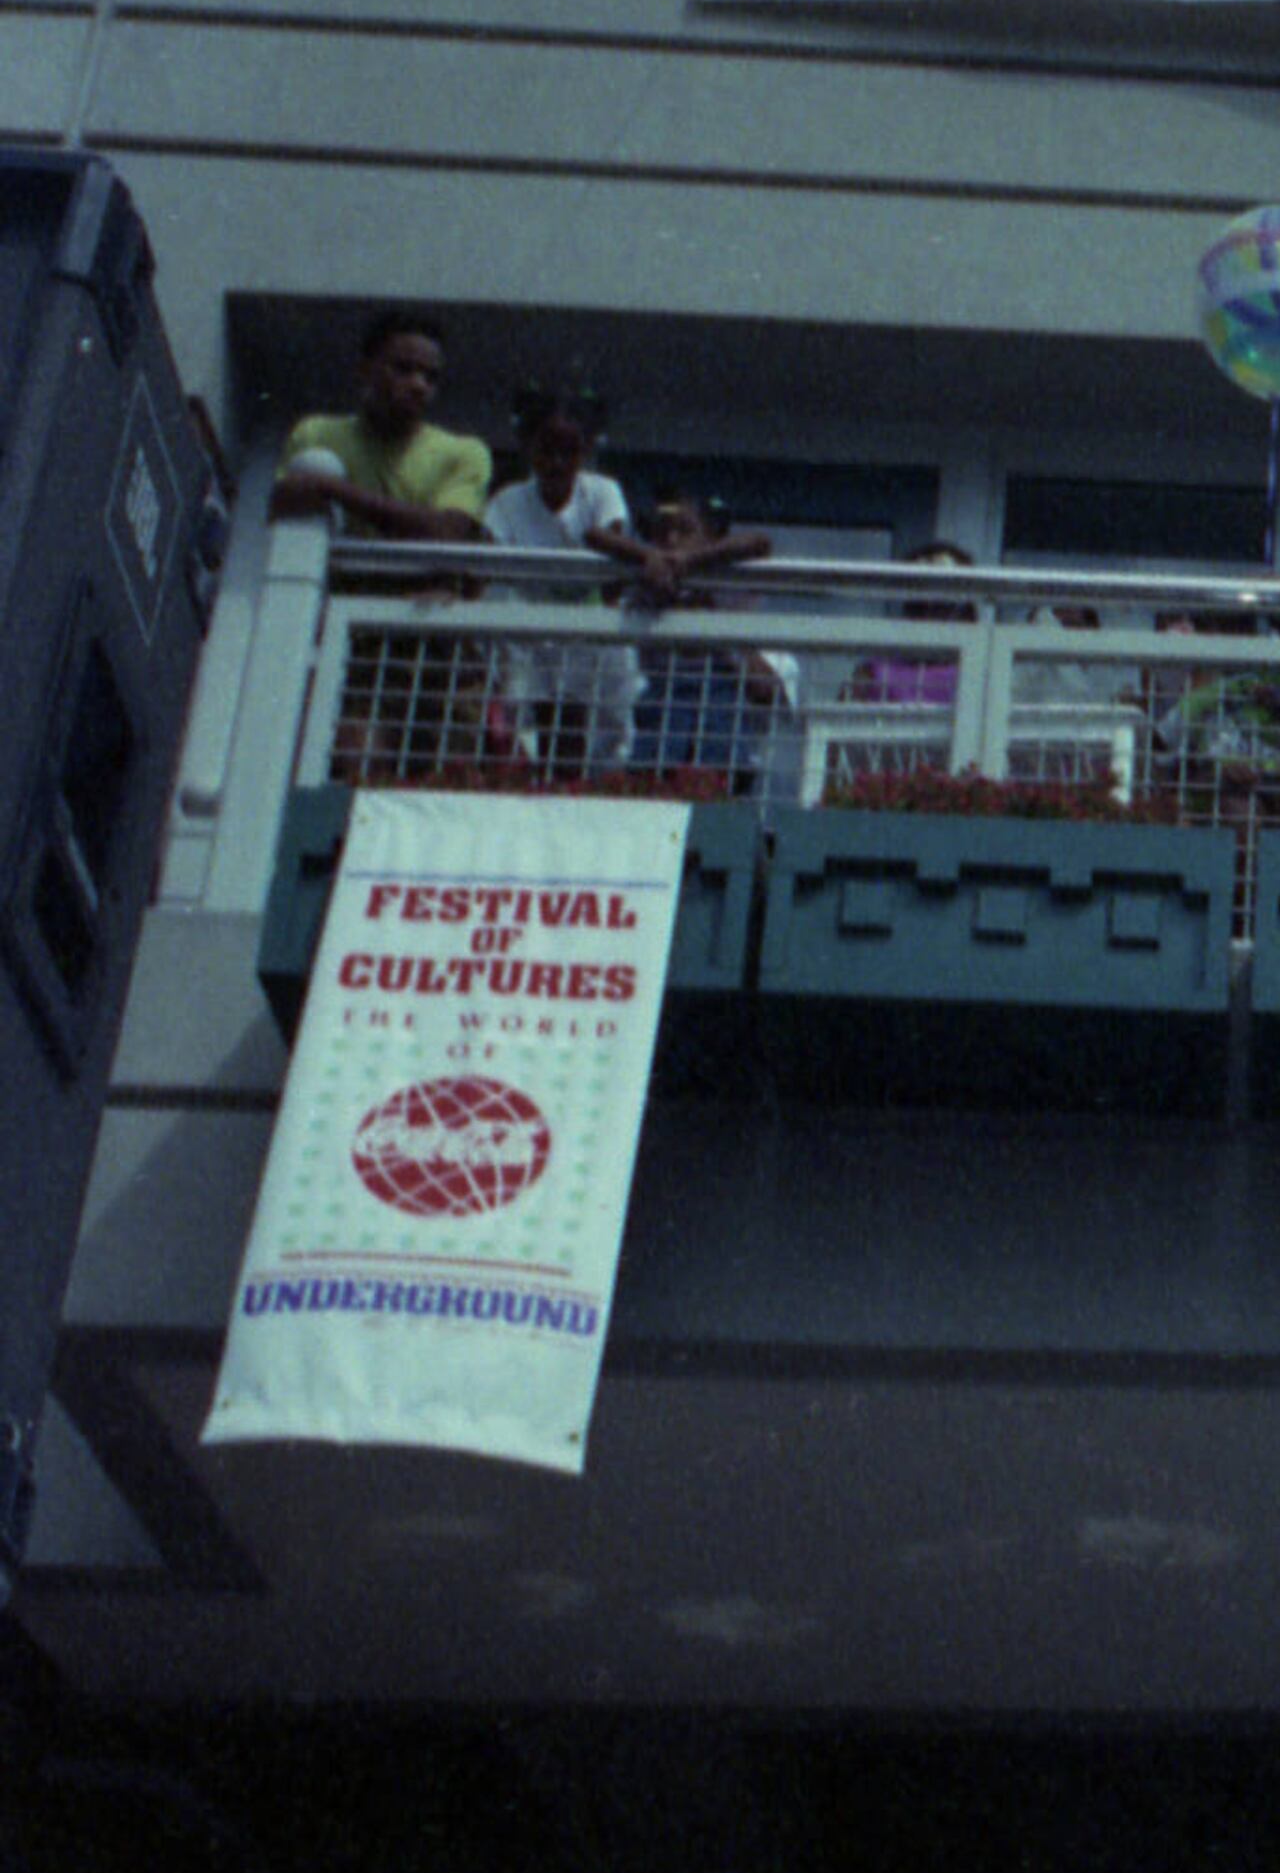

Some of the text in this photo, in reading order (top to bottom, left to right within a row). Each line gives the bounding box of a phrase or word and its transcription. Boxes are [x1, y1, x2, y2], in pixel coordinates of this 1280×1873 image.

[366, 884, 637, 930] FESTIVAL
[471, 927, 522, 954] OF
[338, 953, 637, 1002] CULTURES
[241, 1278, 598, 1336] UNDERGROUND
